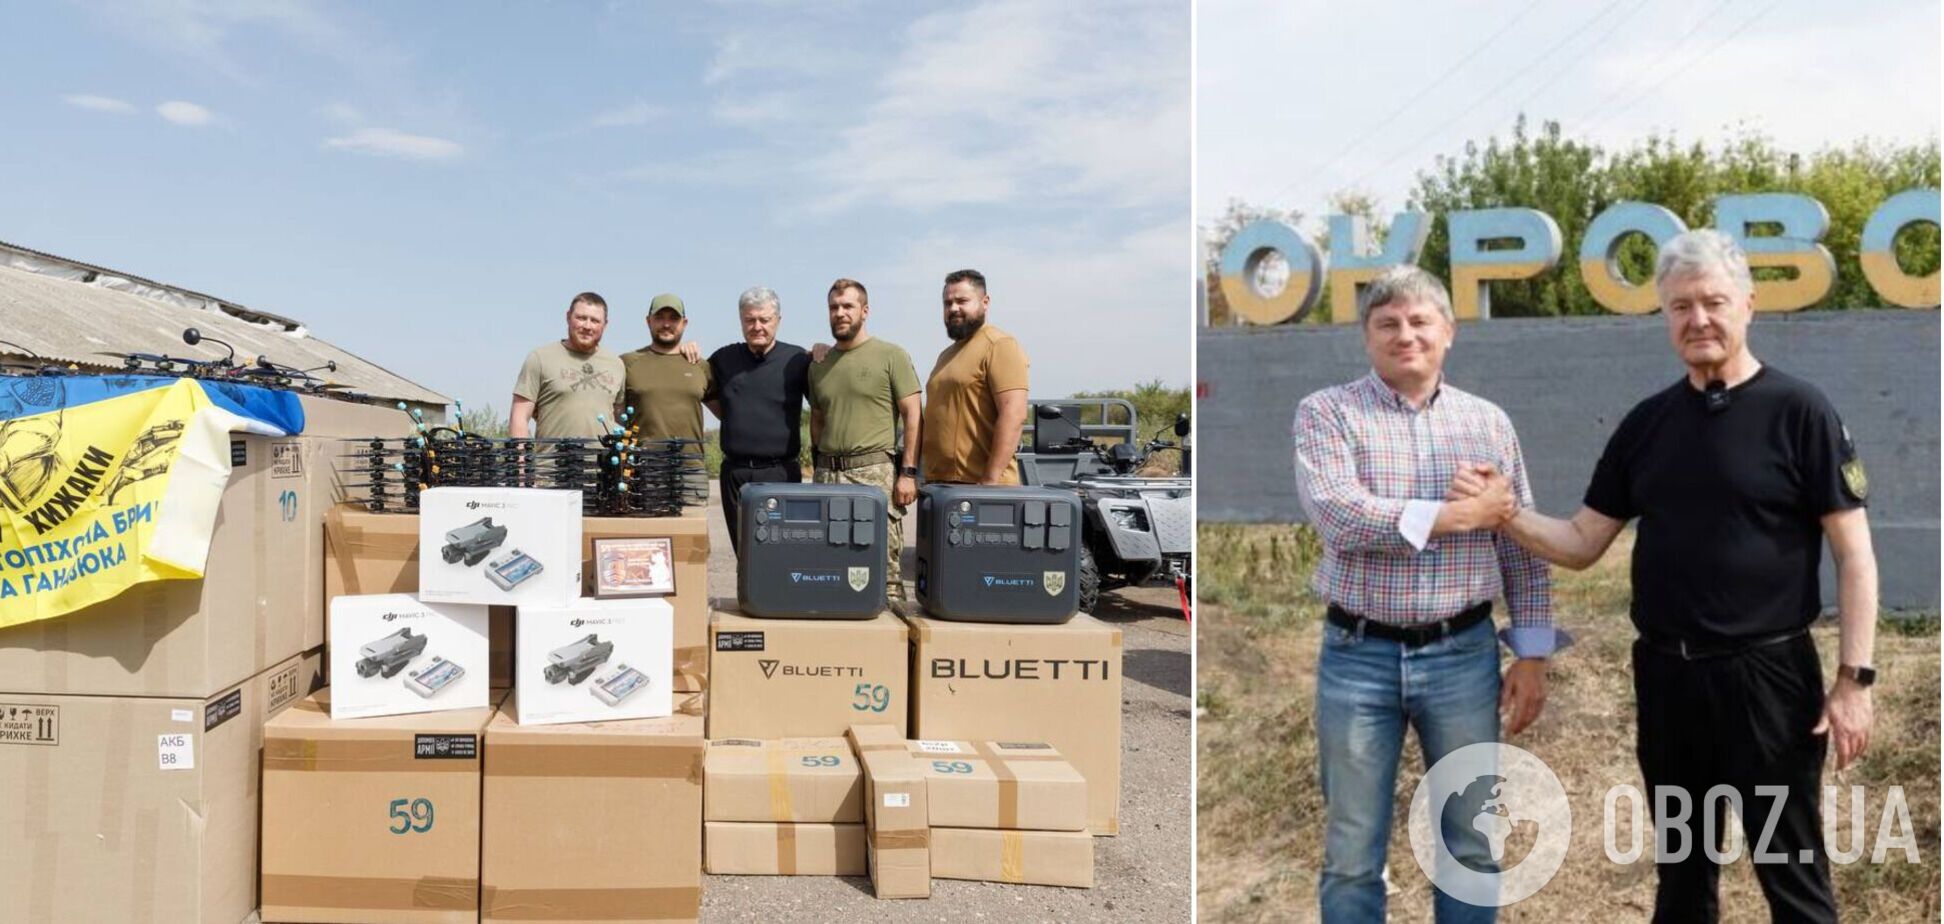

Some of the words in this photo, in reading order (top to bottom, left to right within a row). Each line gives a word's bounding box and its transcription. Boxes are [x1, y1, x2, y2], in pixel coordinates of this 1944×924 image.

[1197, 187, 1940, 327] ОКРОВС
[22, 445, 114, 535] ХИЖАКИ
[279, 490, 297, 522] 10
[112, 500, 158, 535] БРИ
[995, 578, 1034, 586] BLUETTI
[783, 666, 863, 677] BLUETTI
[931, 658, 1108, 680] BLUETTI
[853, 683, 890, 713] 59
[35, 708, 55, 716] ВЕРХ
[160, 736, 184, 747] АКБ
[801, 755, 841, 767] 59
[932, 760, 973, 774] 59
[389, 798, 434, 834] 59
